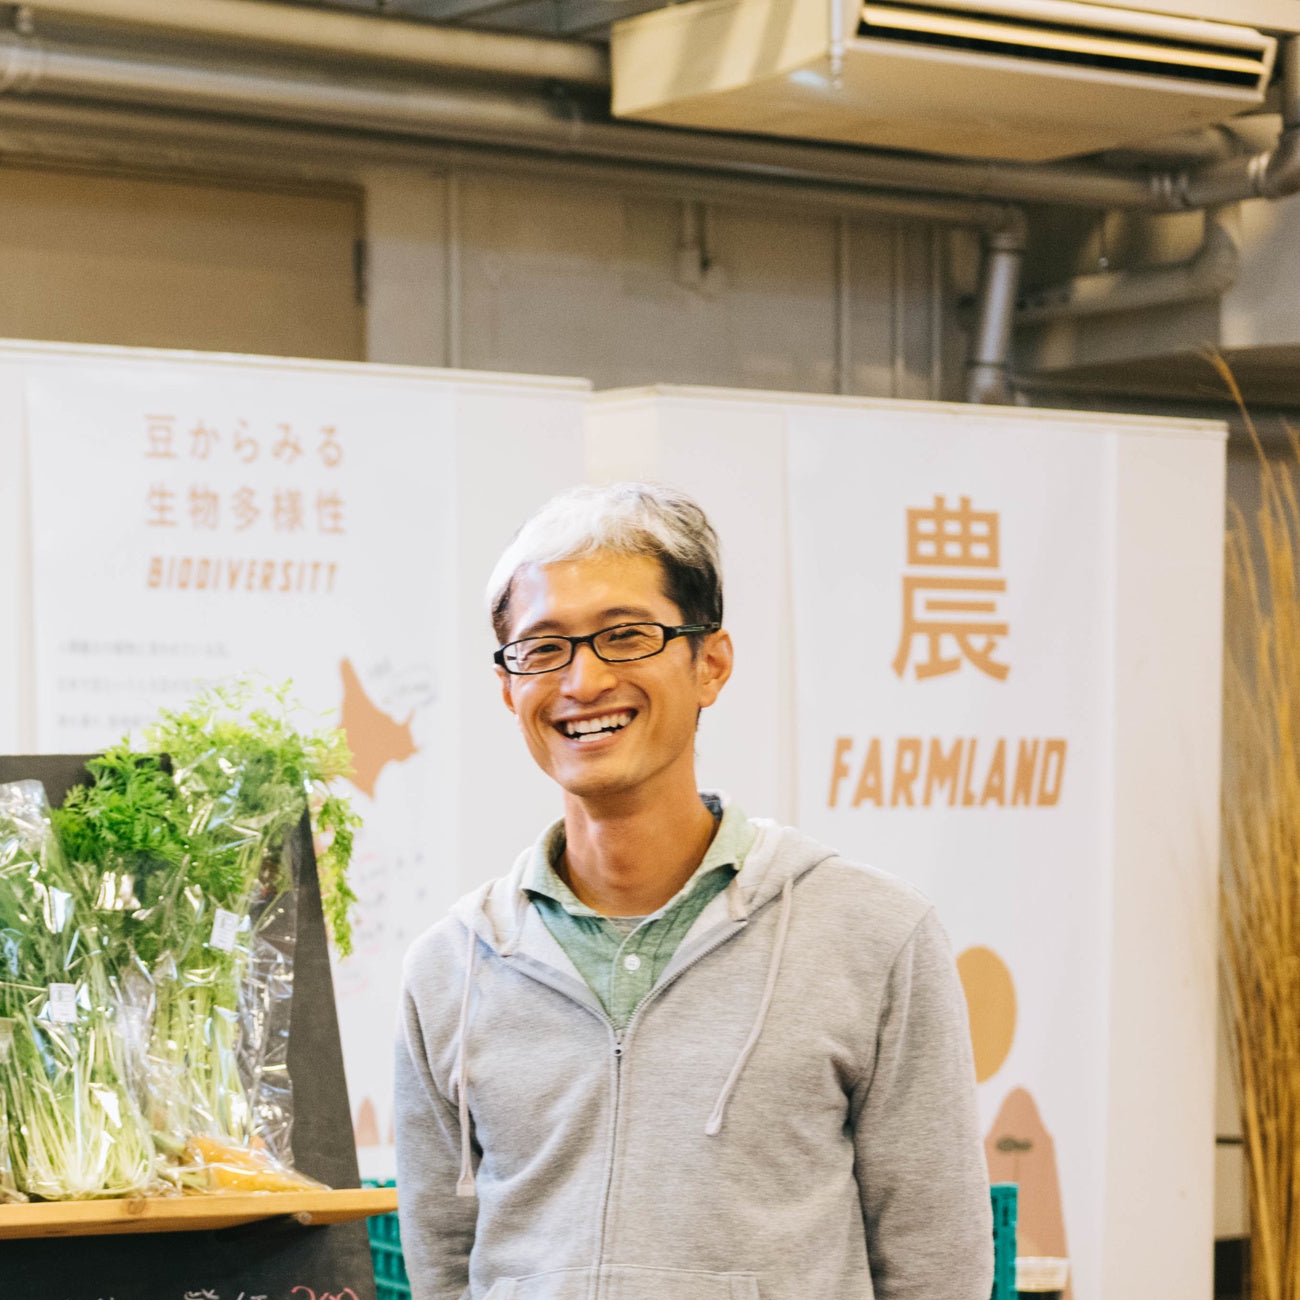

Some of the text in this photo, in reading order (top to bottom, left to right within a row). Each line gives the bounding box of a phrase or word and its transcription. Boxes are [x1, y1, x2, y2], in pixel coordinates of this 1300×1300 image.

[144, 413, 344, 468] 豆からみる
[145, 482, 346, 535] 生物多様性
[146, 555, 340, 594] BIODIVERSITY
[891, 495, 1011, 682] 農
[827, 737, 1068, 808] FARMLAND
